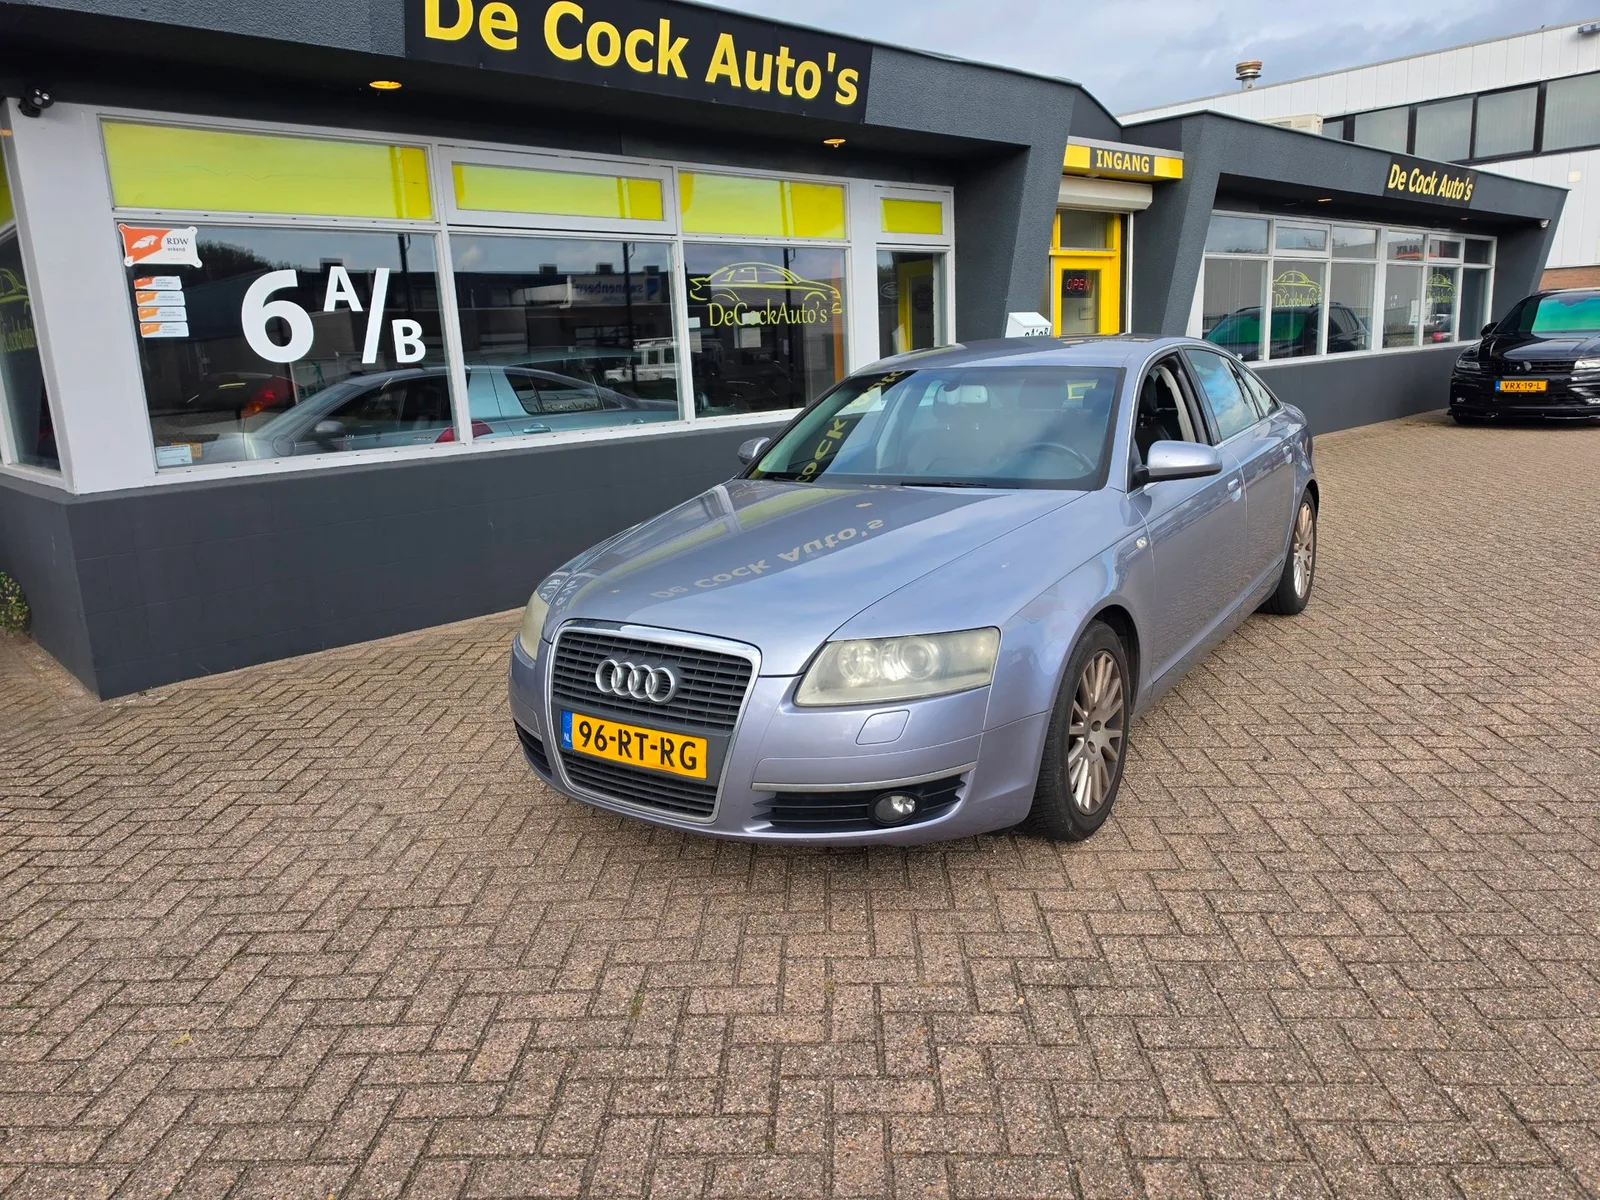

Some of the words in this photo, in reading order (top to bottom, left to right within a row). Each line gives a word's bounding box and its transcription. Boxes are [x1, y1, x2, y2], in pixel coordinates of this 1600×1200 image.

[424, 0, 518, 51] De
[543, 1, 689, 79] Cock
[705, 33, 859, 105] Auto's
[1096, 149, 1150, 173] INGANG
[1387, 163, 1407, 191] De
[1408, 167, 1438, 195] Cock
[1436, 174, 1474, 201] Auto's
[166, 237, 189, 245] RDW
[1066, 278, 1091, 290] OPEN
[241, 269, 314, 363] 6
[706, 300, 828, 326] DeCockAuto's
[1504, 382, 1541, 390] VRX-19-L
[563, 732, 571, 742] NL
[578, 720, 697, 770] 96-RT-RG
